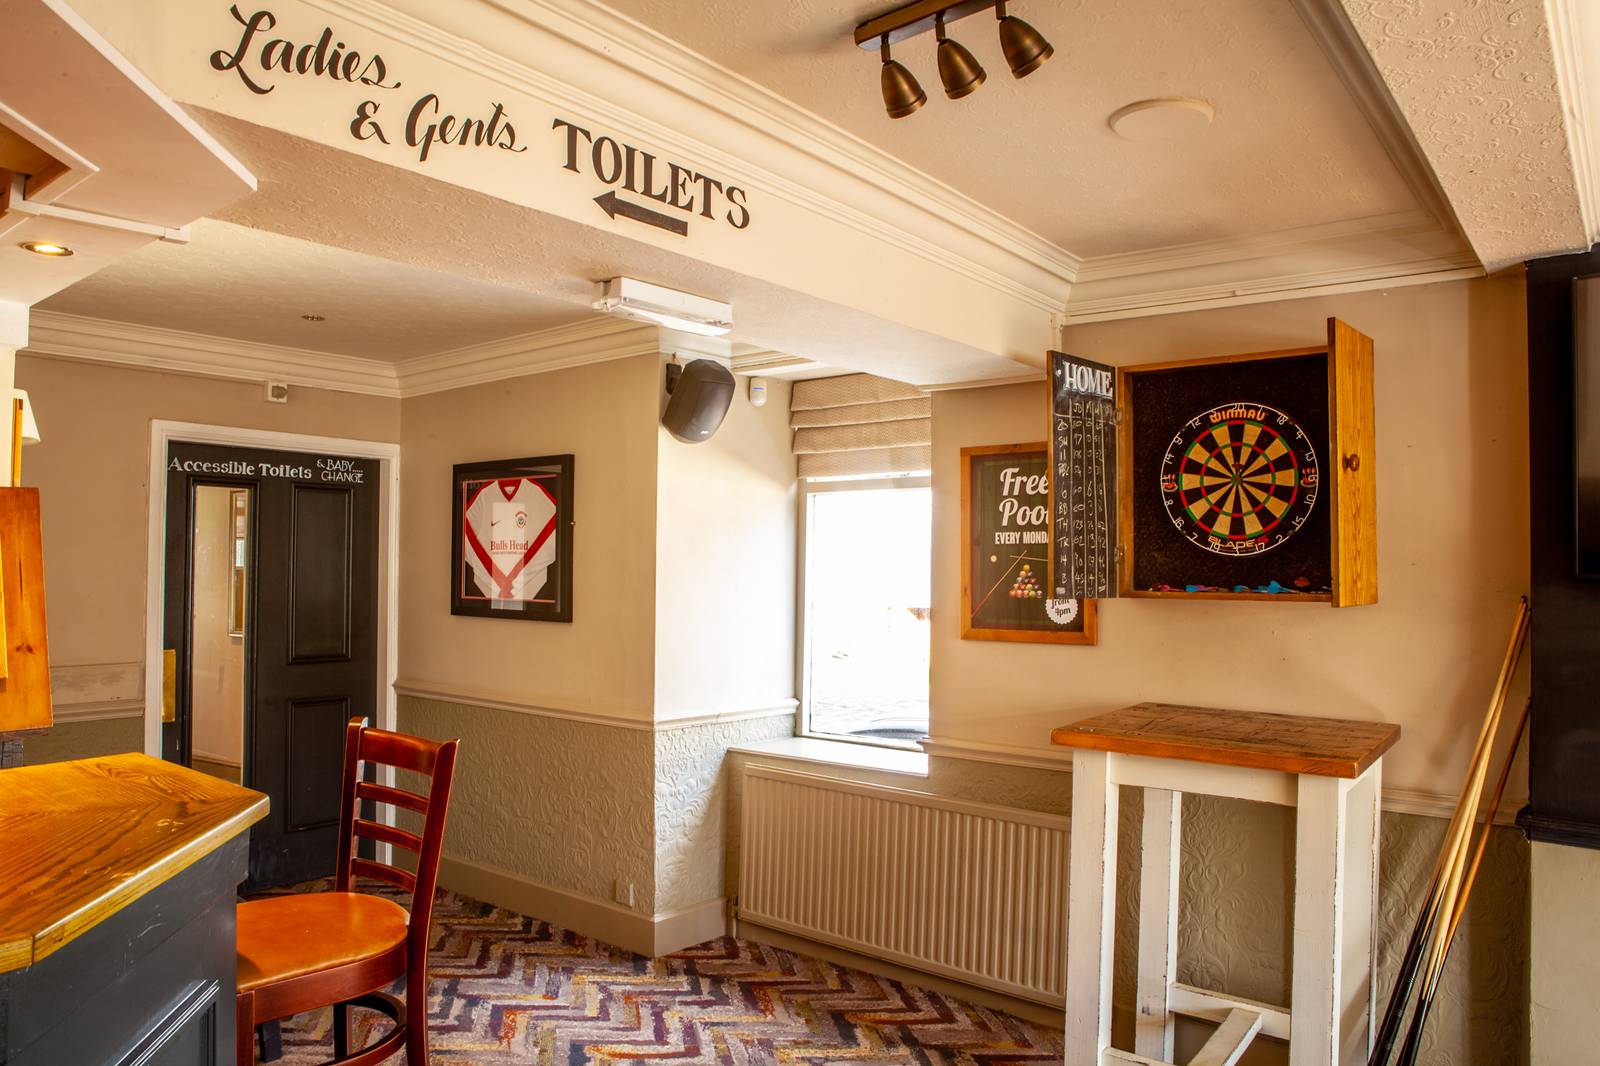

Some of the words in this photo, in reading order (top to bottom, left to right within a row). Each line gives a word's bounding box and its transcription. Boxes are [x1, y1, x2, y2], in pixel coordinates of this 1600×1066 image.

[210, 4, 402, 95] Ladies
[350, 100, 391, 145] &
[404, 93, 527, 163] Gents
[551, 118, 750, 230] TOILETS
[1062, 360, 1113, 399] HOME
[168, 457, 255, 476] Accessible
[258, 463, 312, 479] Toilets
[316, 459, 326, 469] &
[320, 470, 364, 484] CHANGE
[1000, 467, 1049, 497] Free
[490, 540, 509, 550] Bulls
[509, 540, 529, 550] Head
[994, 531, 1021, 545] EVERY
[1022, 531, 1049, 545] MOND
[1054, 607, 1071, 617] 4pm
